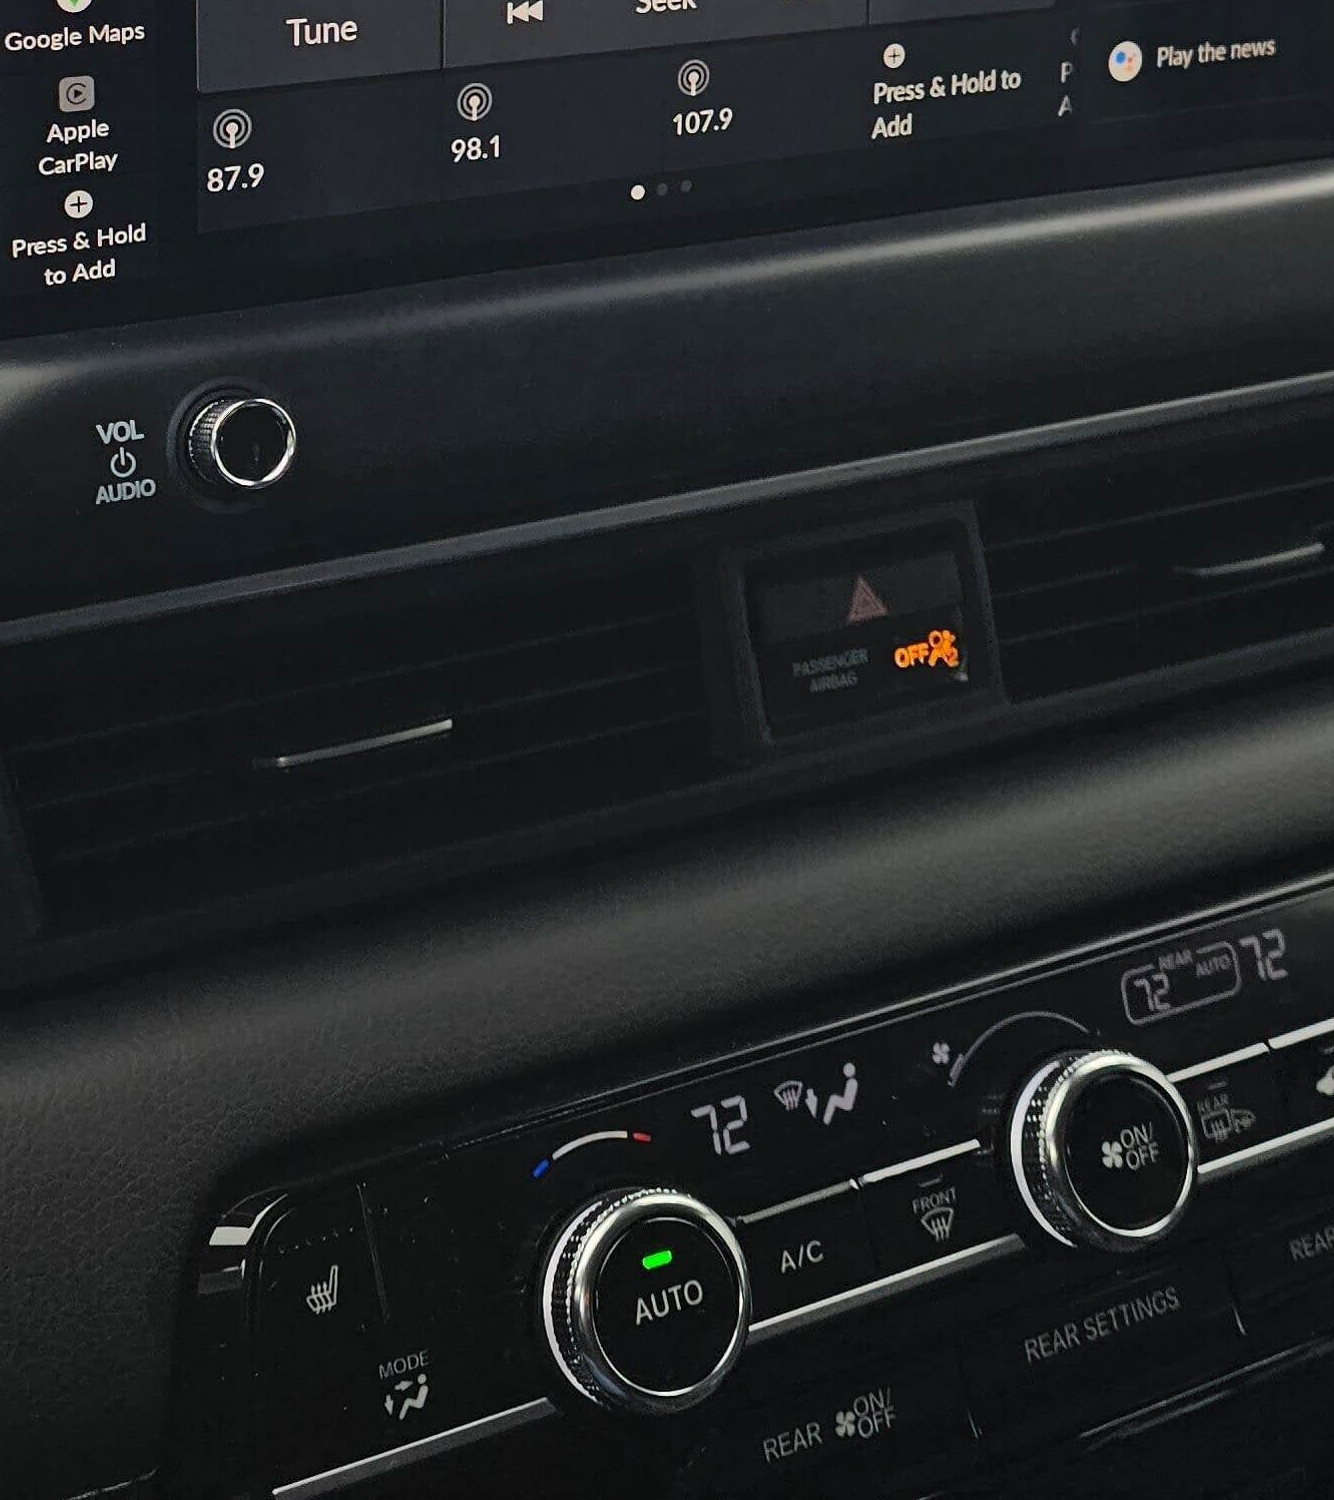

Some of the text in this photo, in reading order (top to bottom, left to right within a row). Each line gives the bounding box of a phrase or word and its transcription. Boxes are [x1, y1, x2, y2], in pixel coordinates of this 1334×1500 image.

[4, 23, 145, 51] Google Maps
[285, 18, 358, 47] Tune
[1156, 39, 1276, 69] Play the news
[873, 69, 1022, 106] Press & Hold to
[46, 118, 110, 145] Apple
[672, 107, 733, 136] 107.9
[871, 112, 913, 140] Add
[38, 150, 119, 176] CarPlay
[451, 134, 500, 163] 98.1
[206, 162, 265, 193] 87.9
[12, 222, 146, 259] Press & Hold
[43, 258, 116, 287] to Add
[94, 419, 145, 444] VOL
[95, 477, 157, 505] AUDIO
[894, 643, 929, 668] OFF
[1236, 928, 1288, 984] 72
[1132, 973, 1172, 1012] 72
[690, 1095, 751, 1155] 72
[1120, 1120, 1156, 1148] ON/
[1124, 1141, 1161, 1172] OFF
[911, 1184, 956, 1217] FRONT
[781, 1240, 824, 1273] A/C
[635, 1279, 703, 1325] AUTO
[1024, 1286, 1181, 1363] REAR SETTINGS
[378, 1351, 427, 1383] MODE
[852, 1385, 893, 1419] ON/
[856, 1404, 898, 1440] OFF
[762, 1422, 823, 1462] REAR
